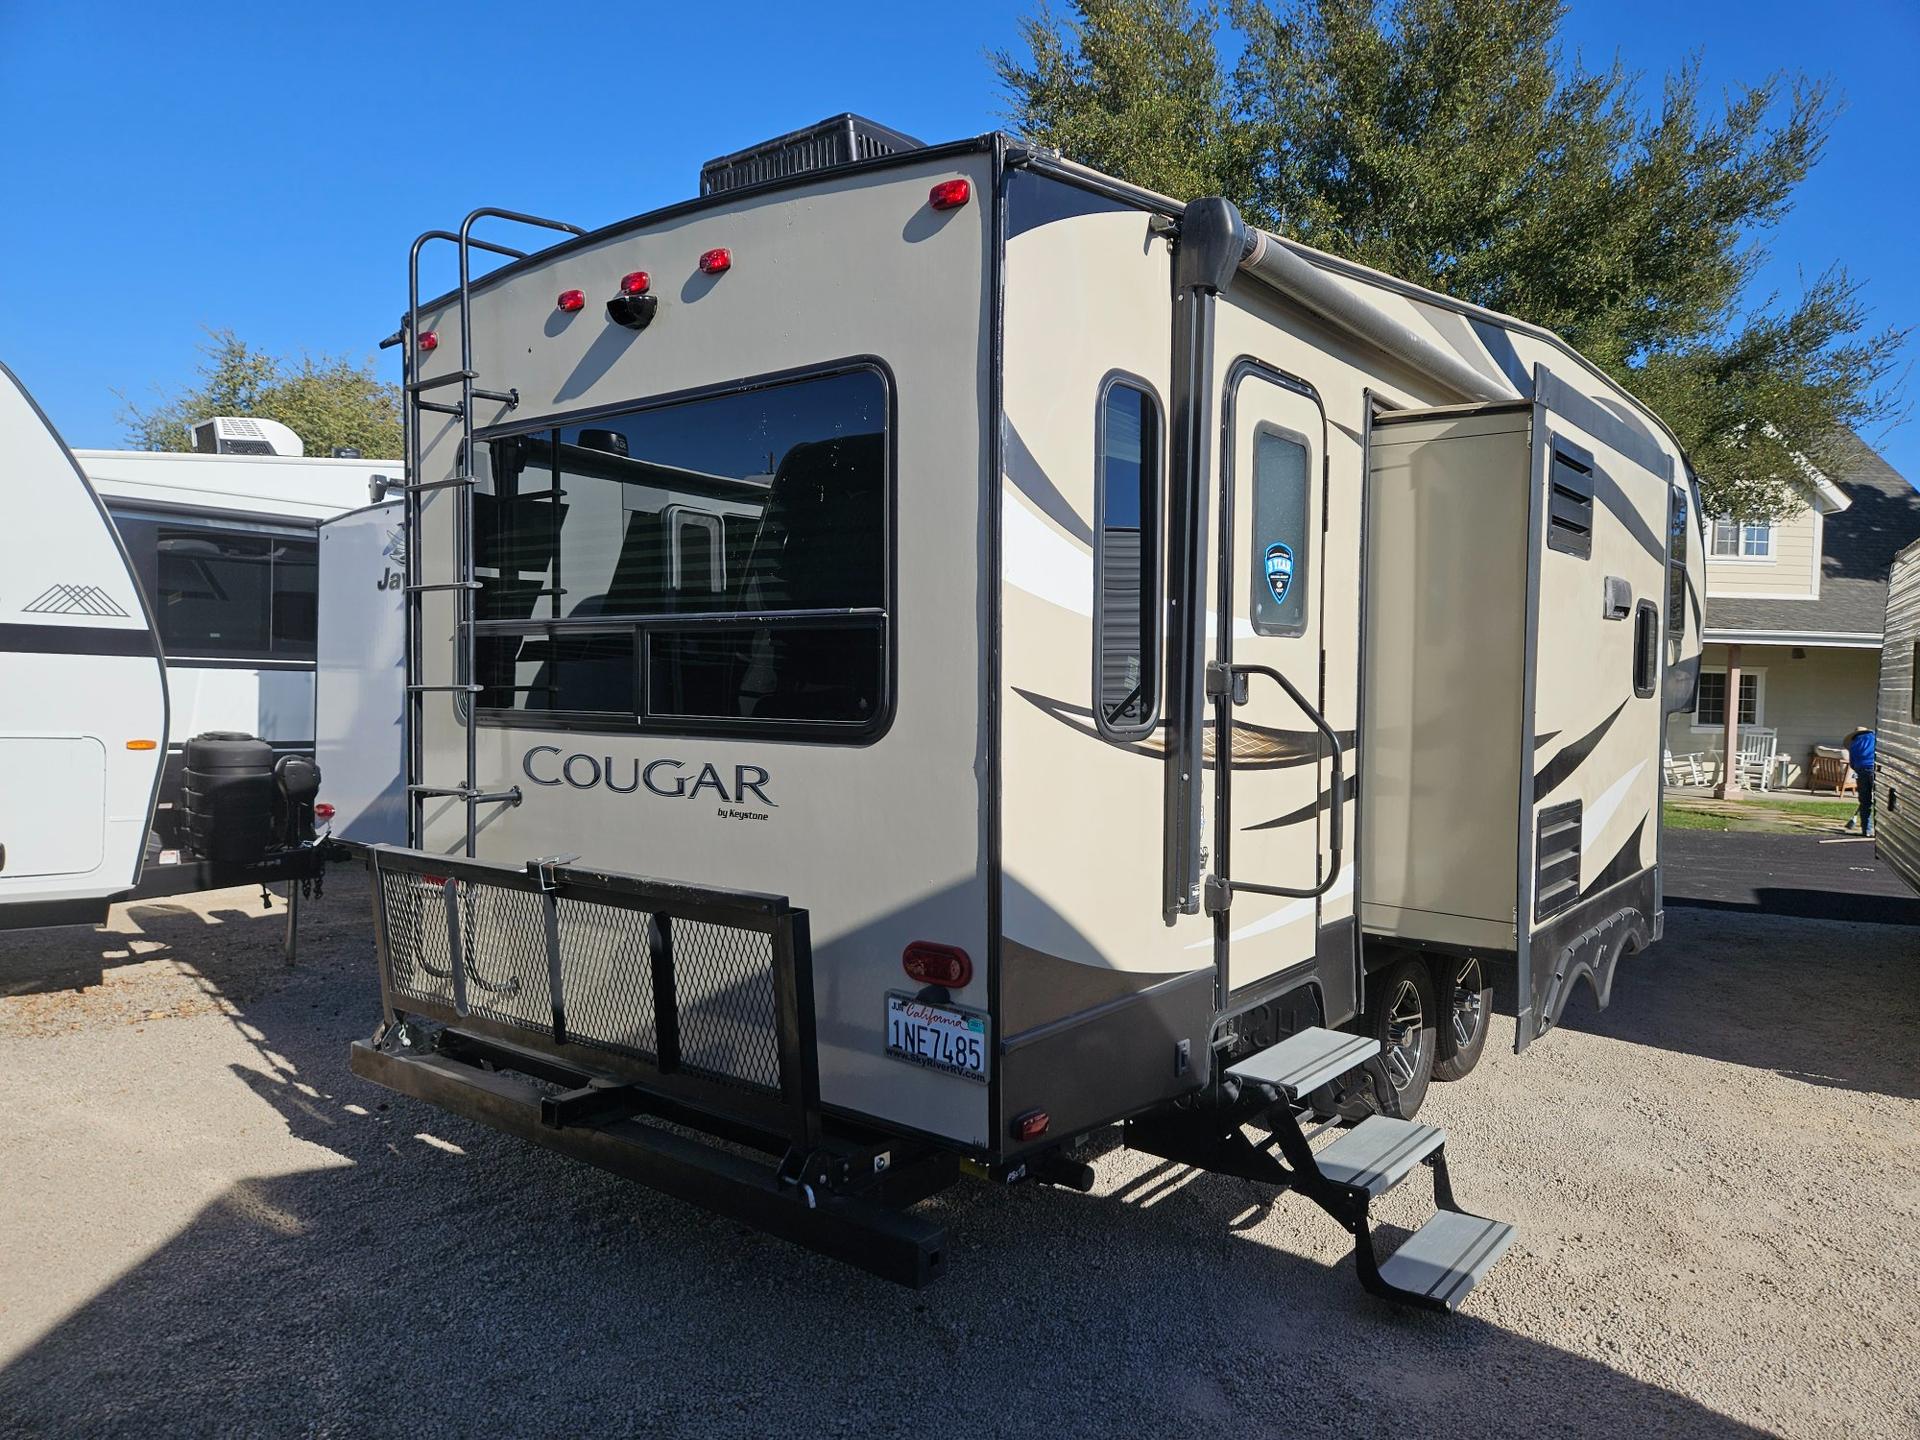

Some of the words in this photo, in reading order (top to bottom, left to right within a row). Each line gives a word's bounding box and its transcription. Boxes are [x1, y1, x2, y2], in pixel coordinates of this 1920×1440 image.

[523, 745, 779, 807] COUGAR
[717, 808, 728, 819] by
[729, 808, 769, 821] Keystone
[906, 1003, 968, 1030] California
[892, 1020, 980, 1071] 1NE7485
[885, 1047, 986, 1083] www.SkyRiverRV.com
